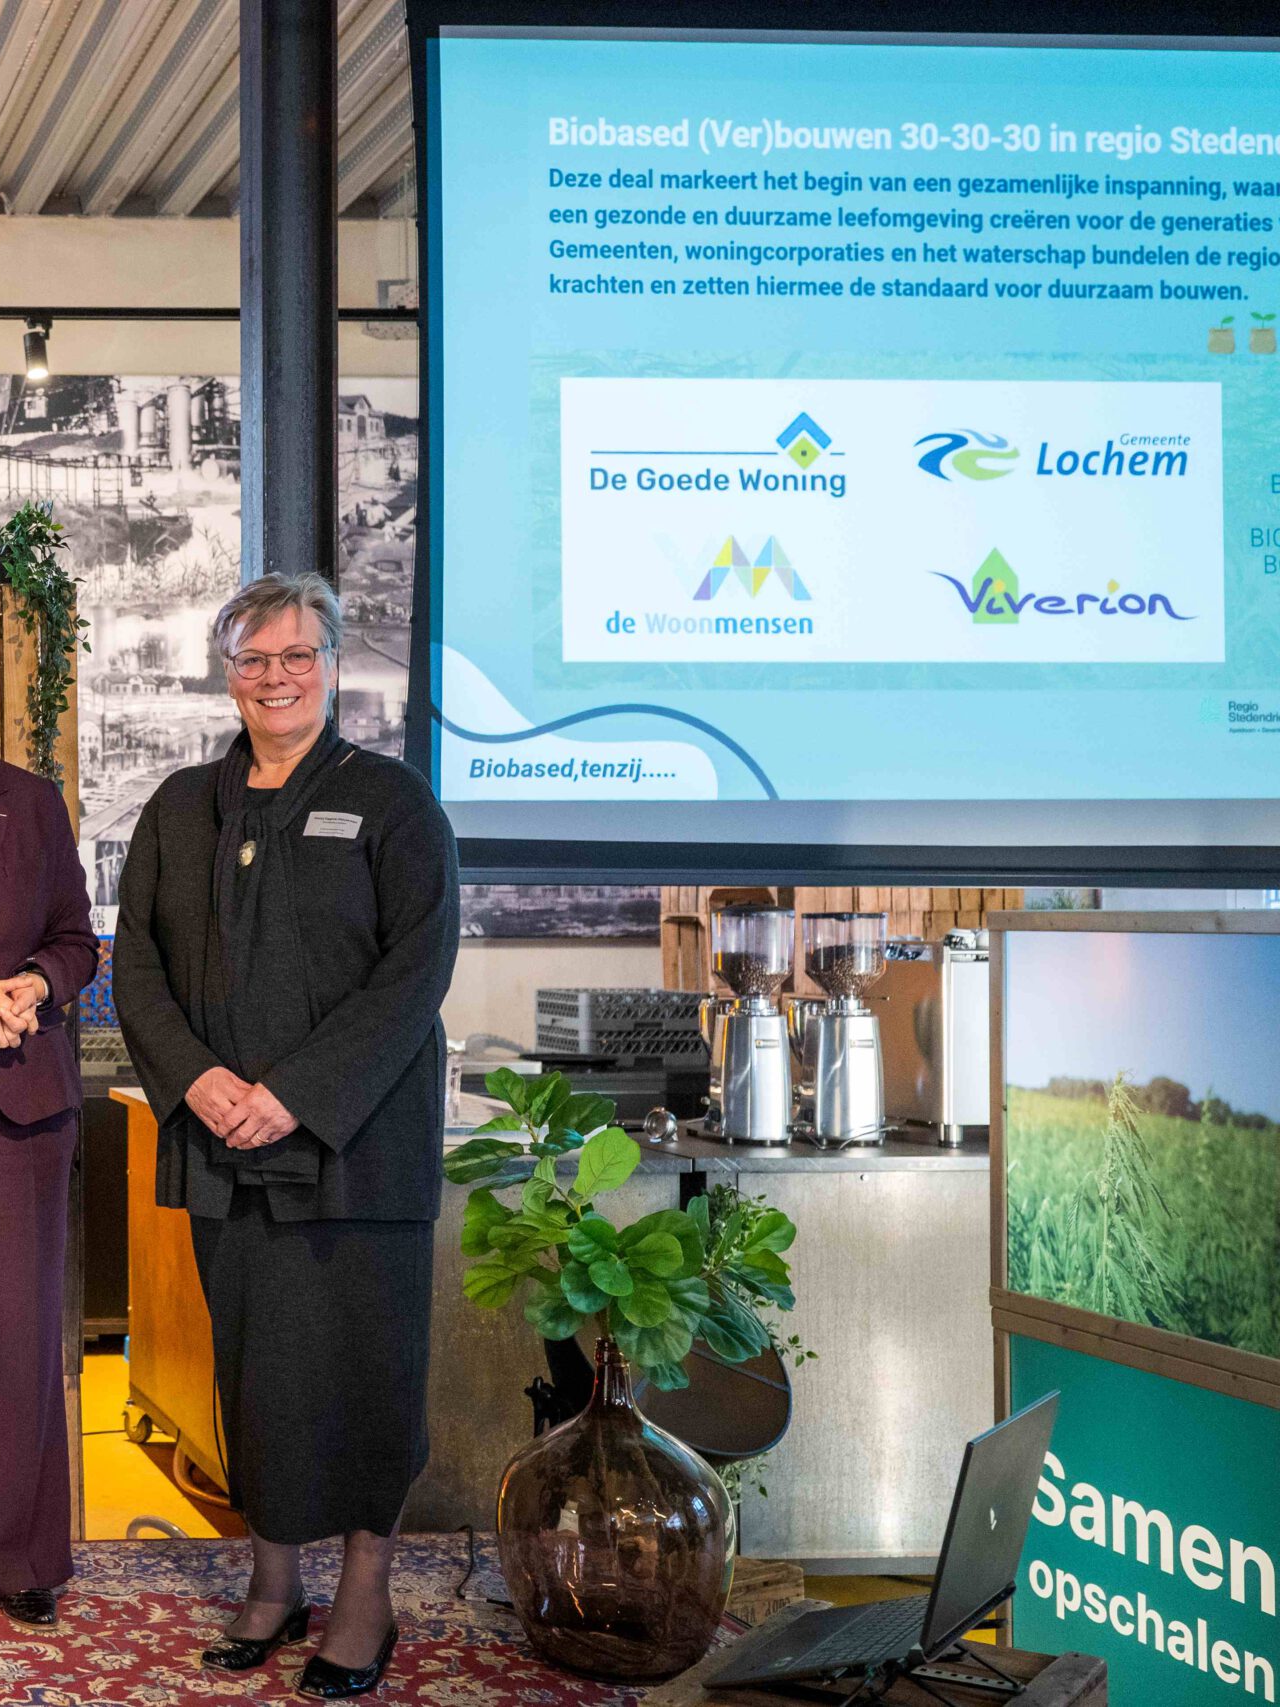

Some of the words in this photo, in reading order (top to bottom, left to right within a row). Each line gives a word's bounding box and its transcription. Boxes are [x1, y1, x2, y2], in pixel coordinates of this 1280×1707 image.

[549, 116, 689, 147] Biobased
[699, 118, 892, 155] (Ver)bouwen
[900, 122, 1041, 152] 30-30-30
[1049, 122, 1077, 153] in
[1085, 124, 1162, 161] regio
[548, 167, 603, 189] Deze
[607, 167, 654, 189] deal
[659, 168, 759, 191] markeert
[762, 169, 799, 191] het
[803, 169, 863, 197] begin
[868, 176, 907, 193] van
[912, 176, 952, 193] een
[957, 173, 1100, 200] gezamenlijke
[1104, 173, 1227, 202] inspanning,
[548, 208, 589, 225] een
[593, 204, 687, 230] gezonde
[691, 209, 719, 226] en
[723, 205, 833, 227] duurzame
[837, 206, 984, 234] leefomgeving
[989, 208, 1071, 230] creëren
[1075, 214, 1125, 231] voor
[1129, 210, 1156, 231] de
[1160, 211, 1274, 237] generaties
[548, 239, 679, 265] Gemeenten,
[684, 239, 885, 267] woningcorporaties
[890, 246, 917, 263] en
[922, 241, 958, 263] het
[962, 243, 1086, 270] waterschap
[1091, 243, 1190, 266] bundelen
[1195, 245, 1222, 266] de
[1227, 246, 1280, 272] regio
[549, 272, 645, 295] krachten
[649, 279, 677, 295] en
[682, 276, 750, 296] zetten
[755, 274, 844, 297] hiermee
[849, 275, 877, 297] de
[881, 276, 989, 298] standaard
[994, 282, 1043, 299] voor
[1047, 277, 1154, 300] duurzaam
[1159, 279, 1249, 301] bouwen.
[1119, 433, 1191, 446] Gemeente
[1036, 440, 1189, 477] Lochem
[590, 467, 627, 492] De
[637, 467, 730, 492] Goede
[739, 468, 846, 499] Woning
[1264, 554, 1280, 574] B
[927, 570, 1200, 620] Viverion
[606, 610, 636, 635] de
[644, 612, 814, 635] Woonmensen
[1227, 700, 1259, 713] Regio
[1031, 1450, 1276, 1617] Samen
[1028, 1559, 1275, 1703] opschalen
